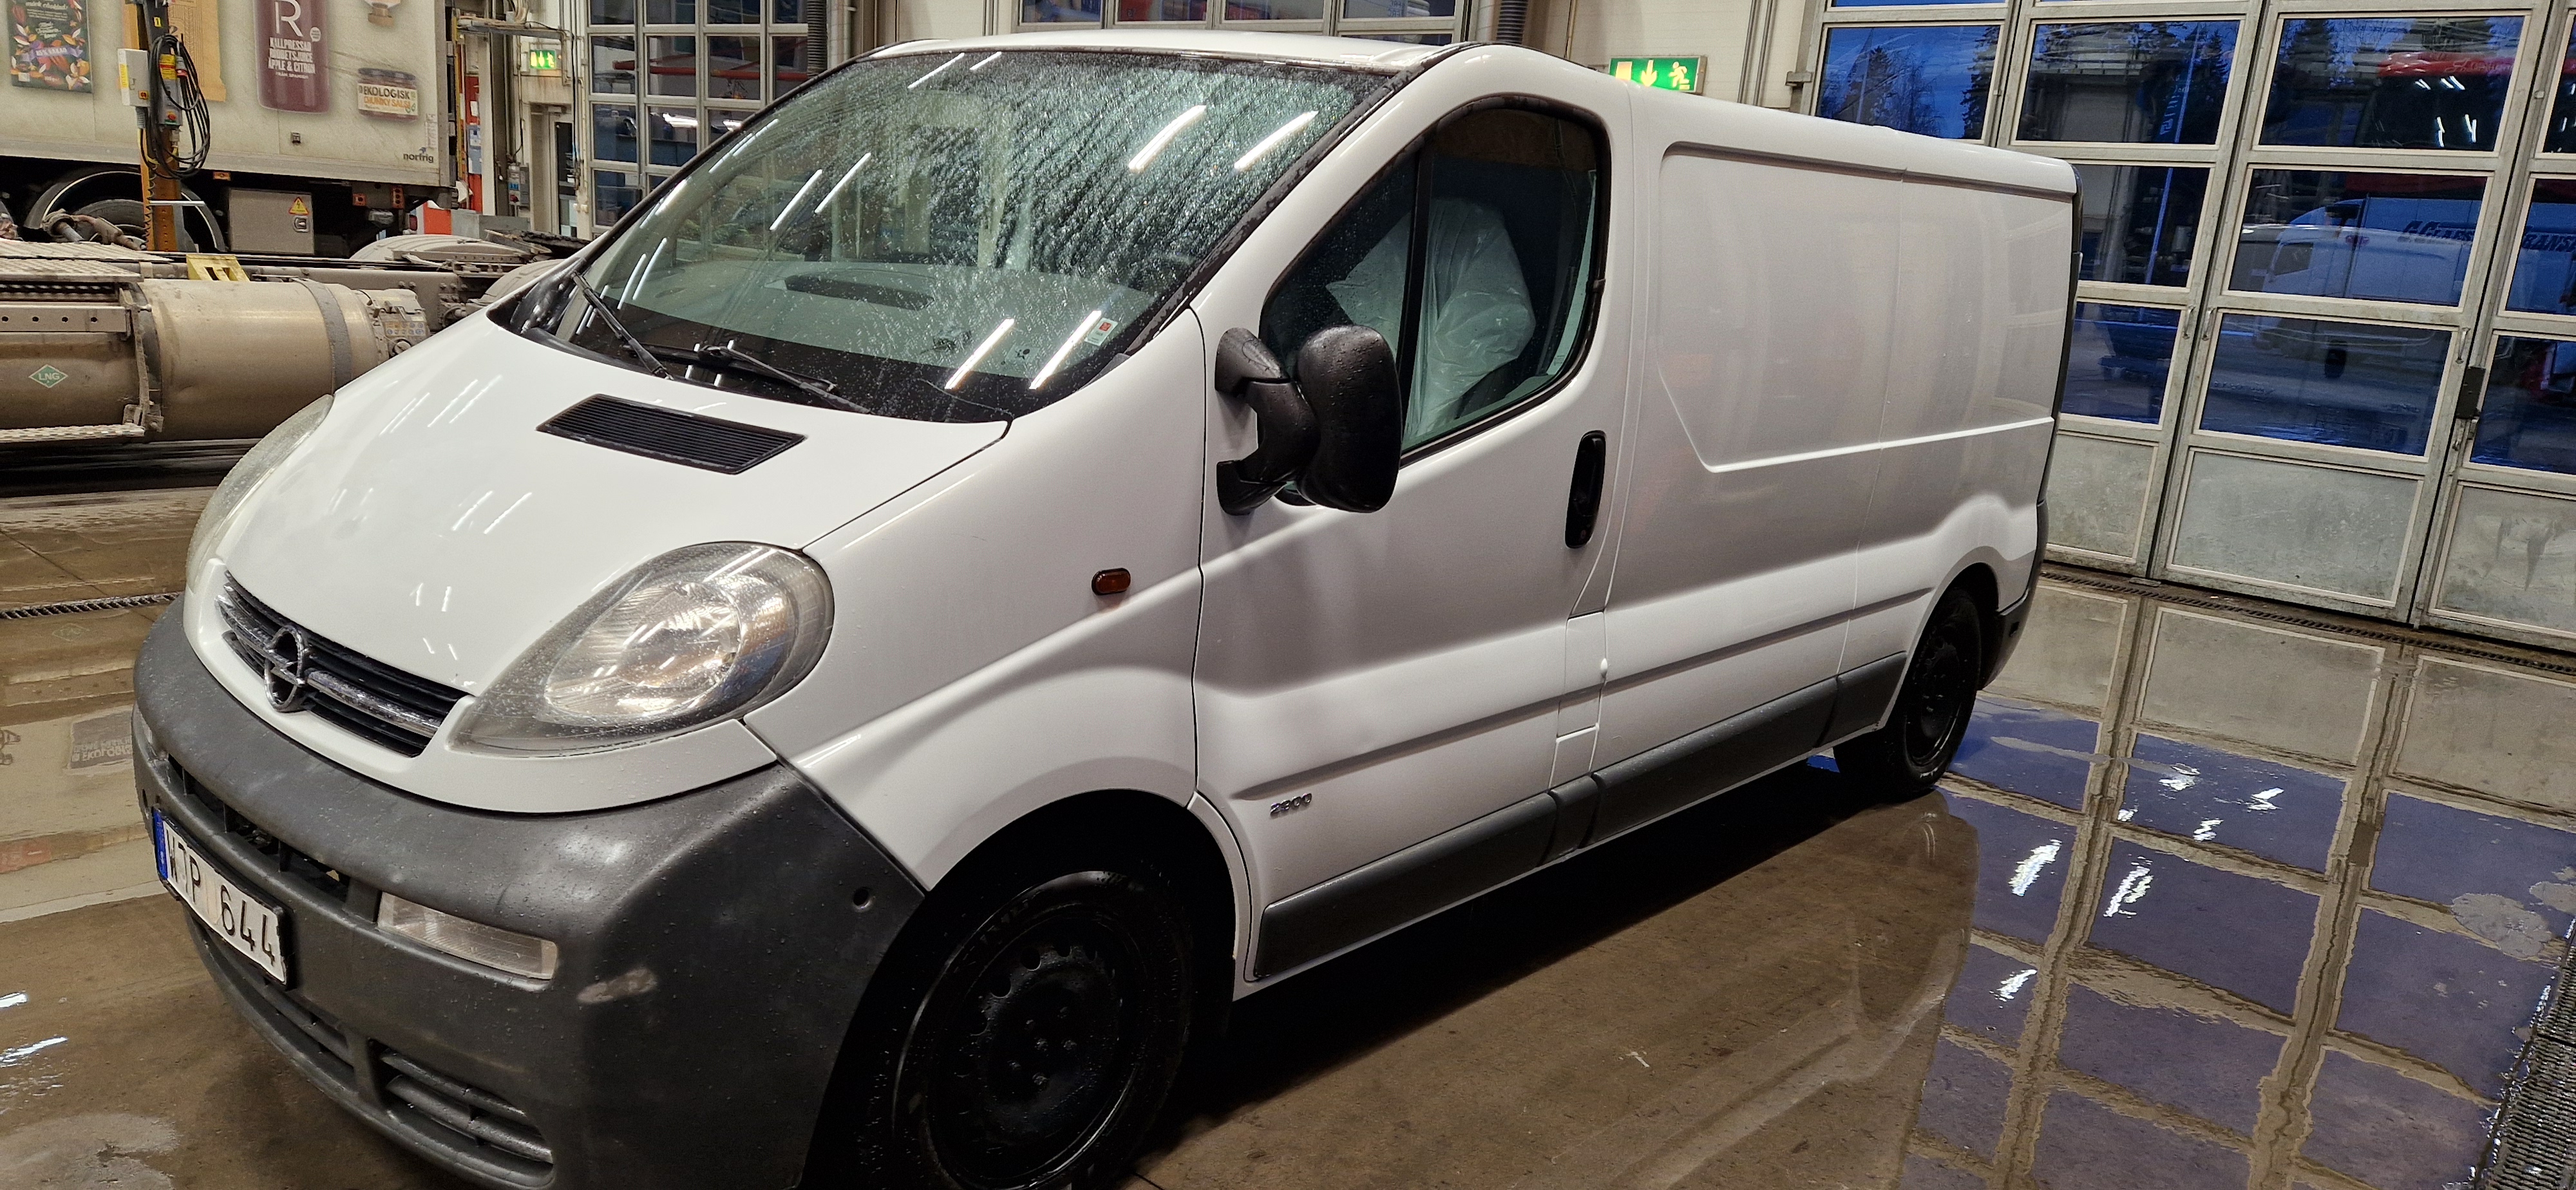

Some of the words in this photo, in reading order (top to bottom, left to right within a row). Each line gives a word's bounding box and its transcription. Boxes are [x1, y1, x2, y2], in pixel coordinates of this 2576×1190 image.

[274, 0, 304, 37] R
[287, 61, 293, 71] &
[294, 62, 316, 75] CITRON
[363, 86, 410, 100] EKOLOGISK
[402, 153, 434, 164] norfrig
[38, 372, 60, 381] LNG
[1270, 793, 1312, 814] 2900
[166, 829, 201, 903] WTP
[220, 883, 276, 967] 644
